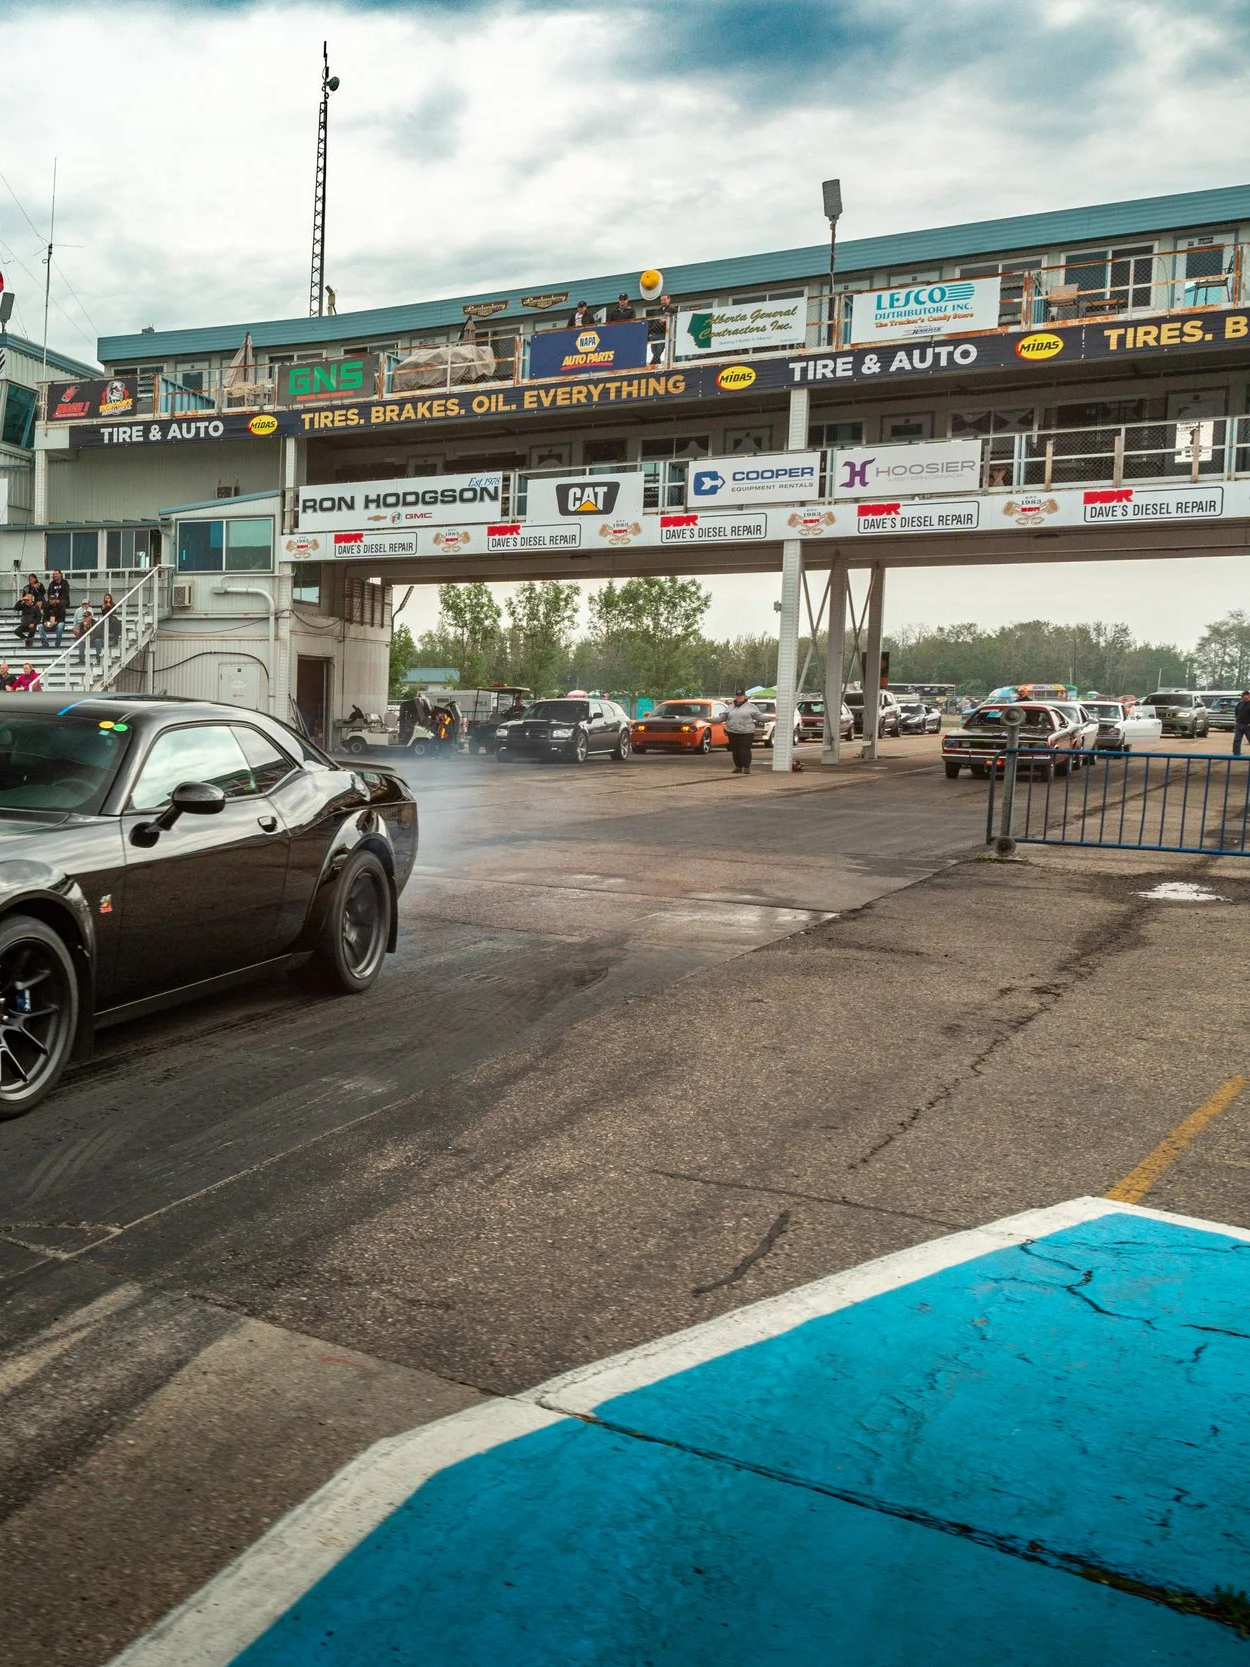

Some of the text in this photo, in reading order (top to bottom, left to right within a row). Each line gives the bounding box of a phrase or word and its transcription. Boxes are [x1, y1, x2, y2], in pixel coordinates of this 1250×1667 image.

[876, 286, 947, 311] LESCO
[703, 305, 798, 326] Alberta General
[875, 303, 973, 320] DISTRIBUTORS INC.
[699, 320, 792, 339] Contractors Inc.
[1104, 319, 1213, 350] TIRES.
[579, 336, 596, 347] NAPA
[562, 351, 615, 367] AUTO PARTS
[788, 343, 978, 382] TIRE & AUTO
[288, 361, 364, 396] GNS
[301, 374, 686, 430] TIRES. BRAKES. OIL. EVERYTHING
[100, 420, 224, 444] TIRE & AUTO
[732, 466, 814, 482] COOPER
[876, 460, 976, 478] HOOSIER
[928, 472, 965, 480] CANADA
[731, 484, 776, 493] EQUIPMENT
[302, 485, 500, 514] RON HODGSON
[567, 486, 608, 513] CAT
[404, 512, 433, 520] GMC
[1090, 500, 1217, 518] DAVE'S DIESEL REPAIR
[863, 513, 973, 530] DAVE'S DIESEL REPAIR
[491, 534, 577, 548] DAVE'S DIESEL REPAIR
[665, 525, 762, 540] DAVE'S DIESEL REPAIR
[337, 542, 414, 555] DAVE'S DIESEL REPAIR
